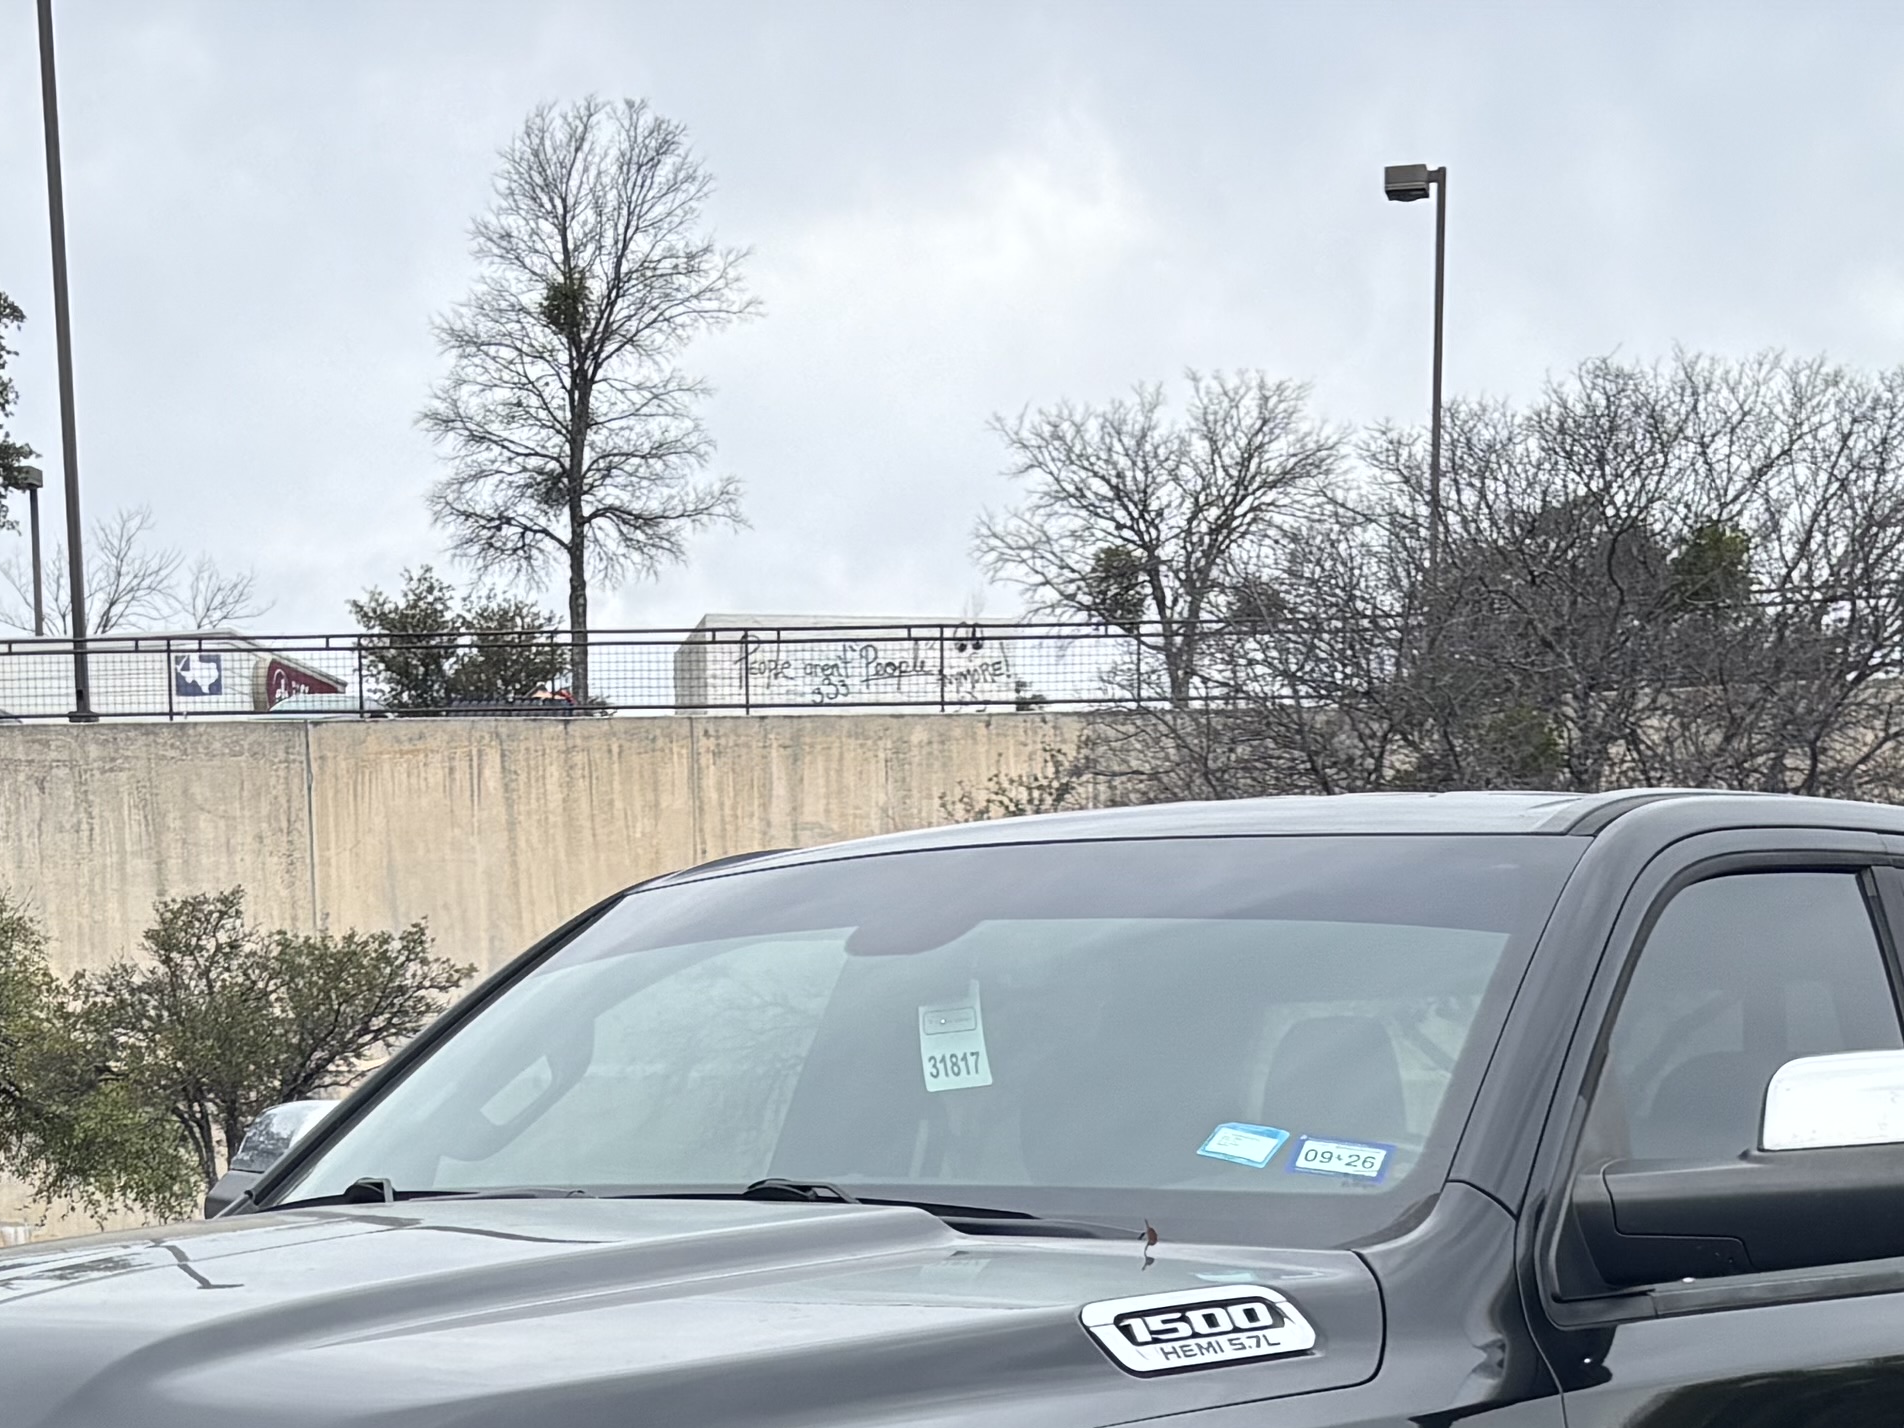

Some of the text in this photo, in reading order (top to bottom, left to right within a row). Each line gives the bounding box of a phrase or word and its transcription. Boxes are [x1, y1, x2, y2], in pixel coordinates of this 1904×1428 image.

[928, 1051, 980, 1079] 31817
[1119, 1302, 1273, 1343] 1500
[1159, 1334, 1282, 1361] HEMI 5.7L
